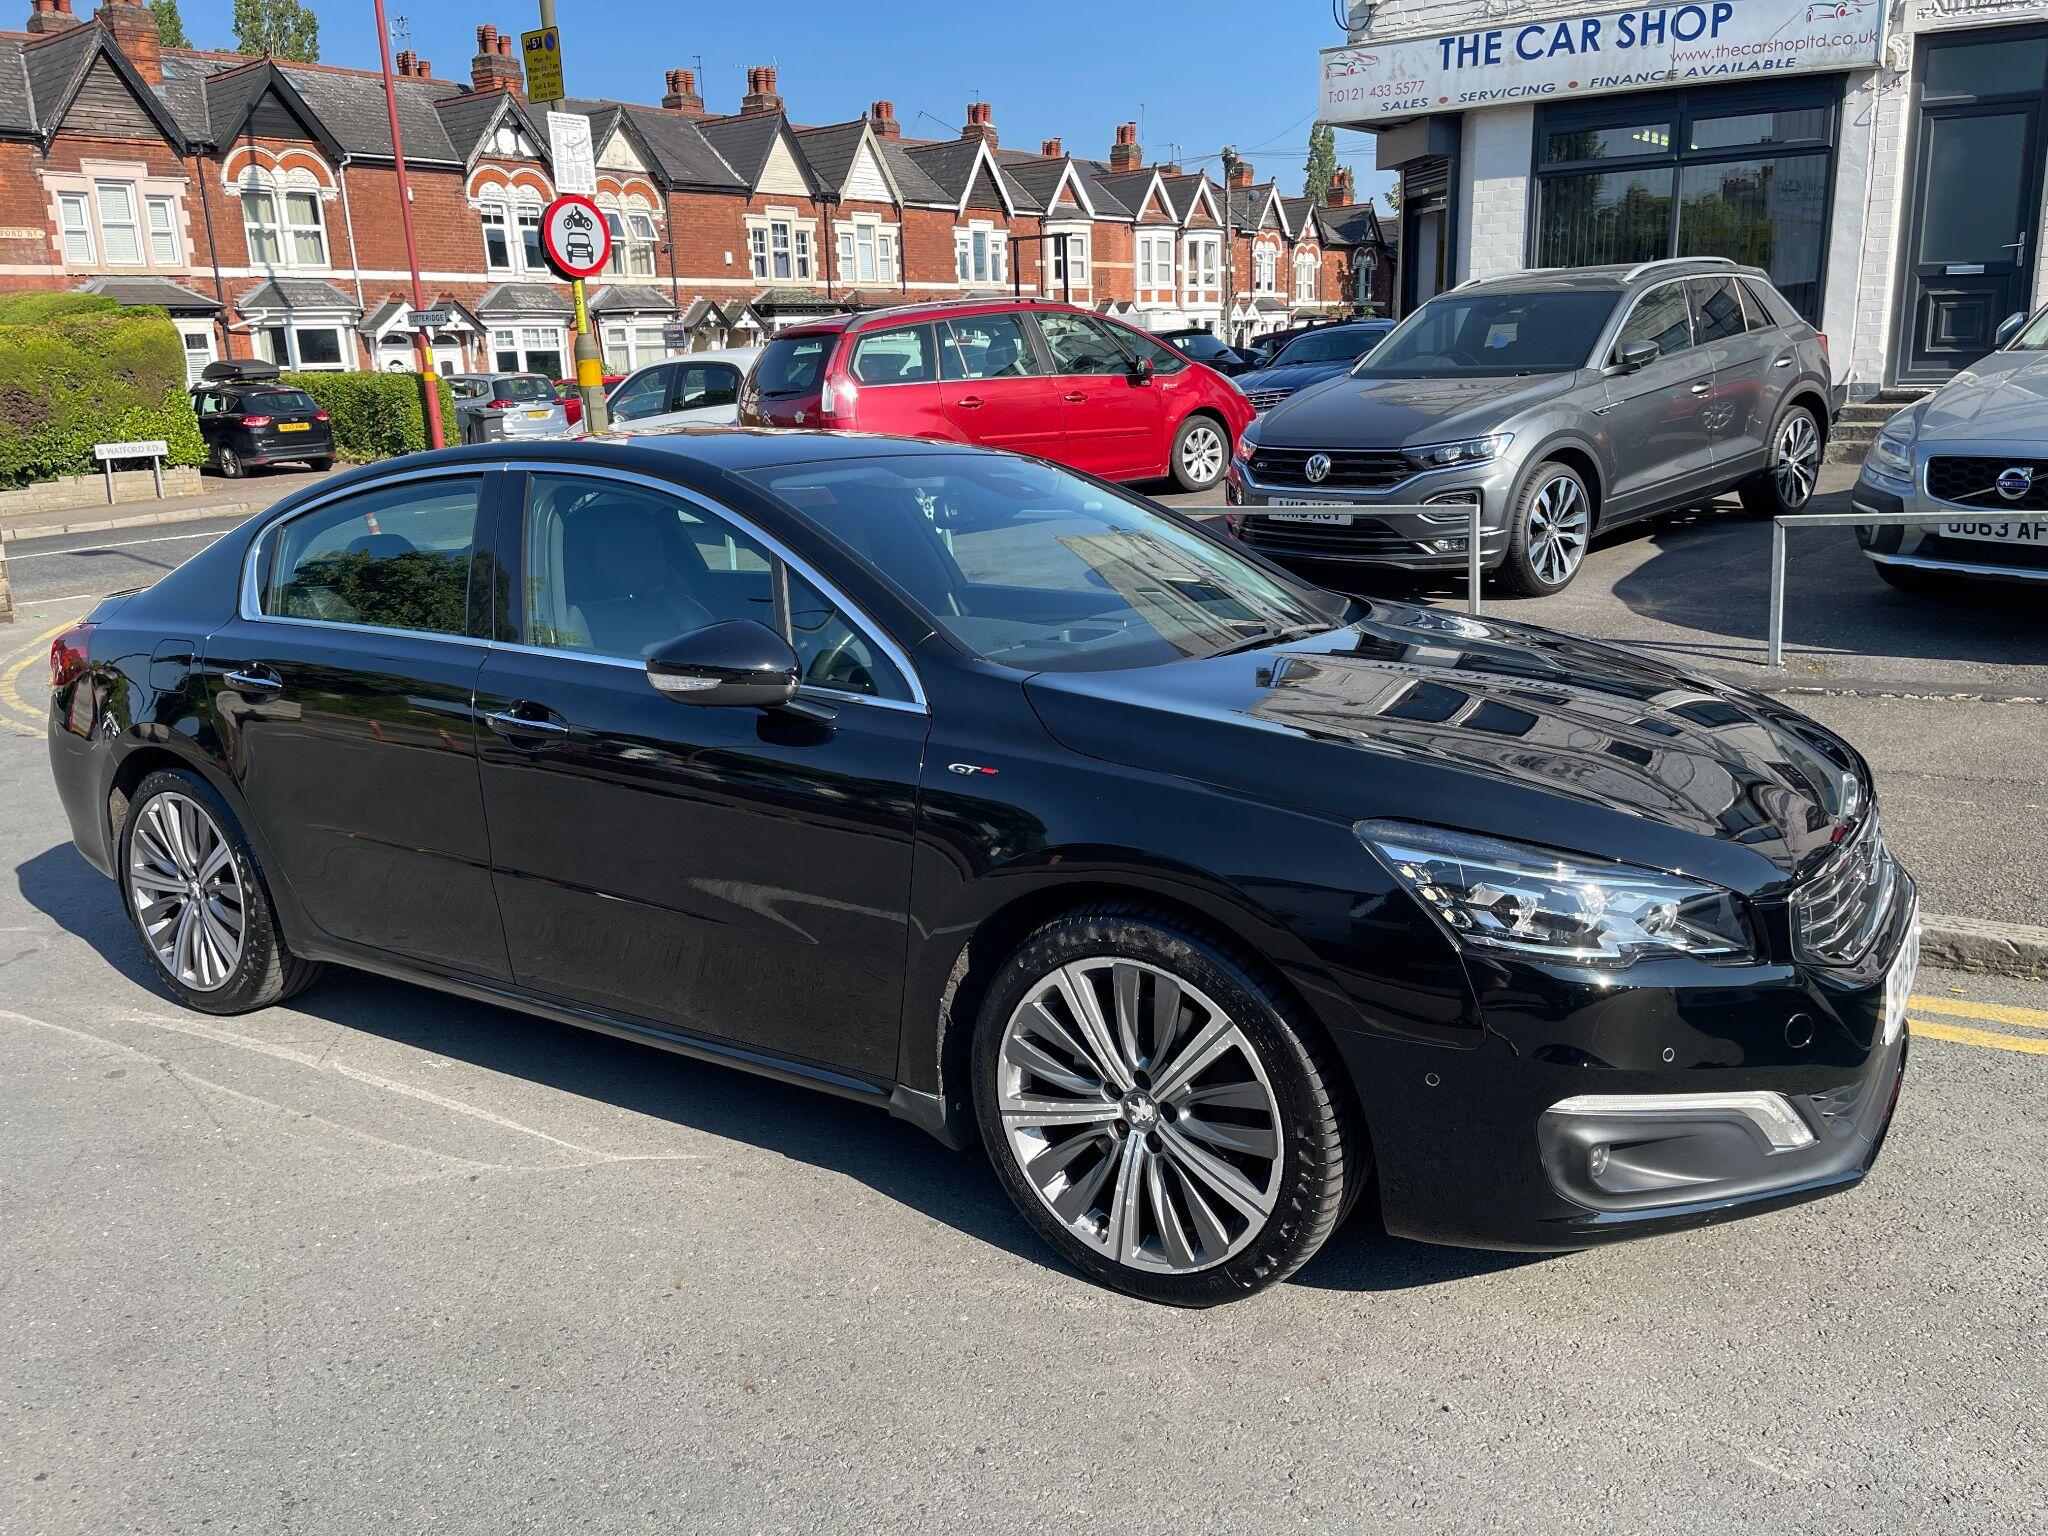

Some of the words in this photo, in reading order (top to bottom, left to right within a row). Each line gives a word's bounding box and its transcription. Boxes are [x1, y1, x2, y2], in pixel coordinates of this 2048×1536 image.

[1439, 31, 1502, 71] THE
[1515, 19, 1601, 60] CAR
[1615, 2, 1733, 49] SHOP
[1669, 30, 1878, 63] www.thecarshopltd.co.uk
[1328, 88, 1365, 103] T:0121
[1369, 84, 1392, 98] 433
[1394, 80, 1425, 96] 5577
[1380, 97, 1429, 112] SALES
[1458, 83, 1556, 103] SERVICING
[1589, 69, 1678, 88] FINANCE
[1683, 57, 1797, 78] AVAILABLE
[409, 314, 445, 322] COTTERIDGE
[106, 445, 145, 455] WATFORD
